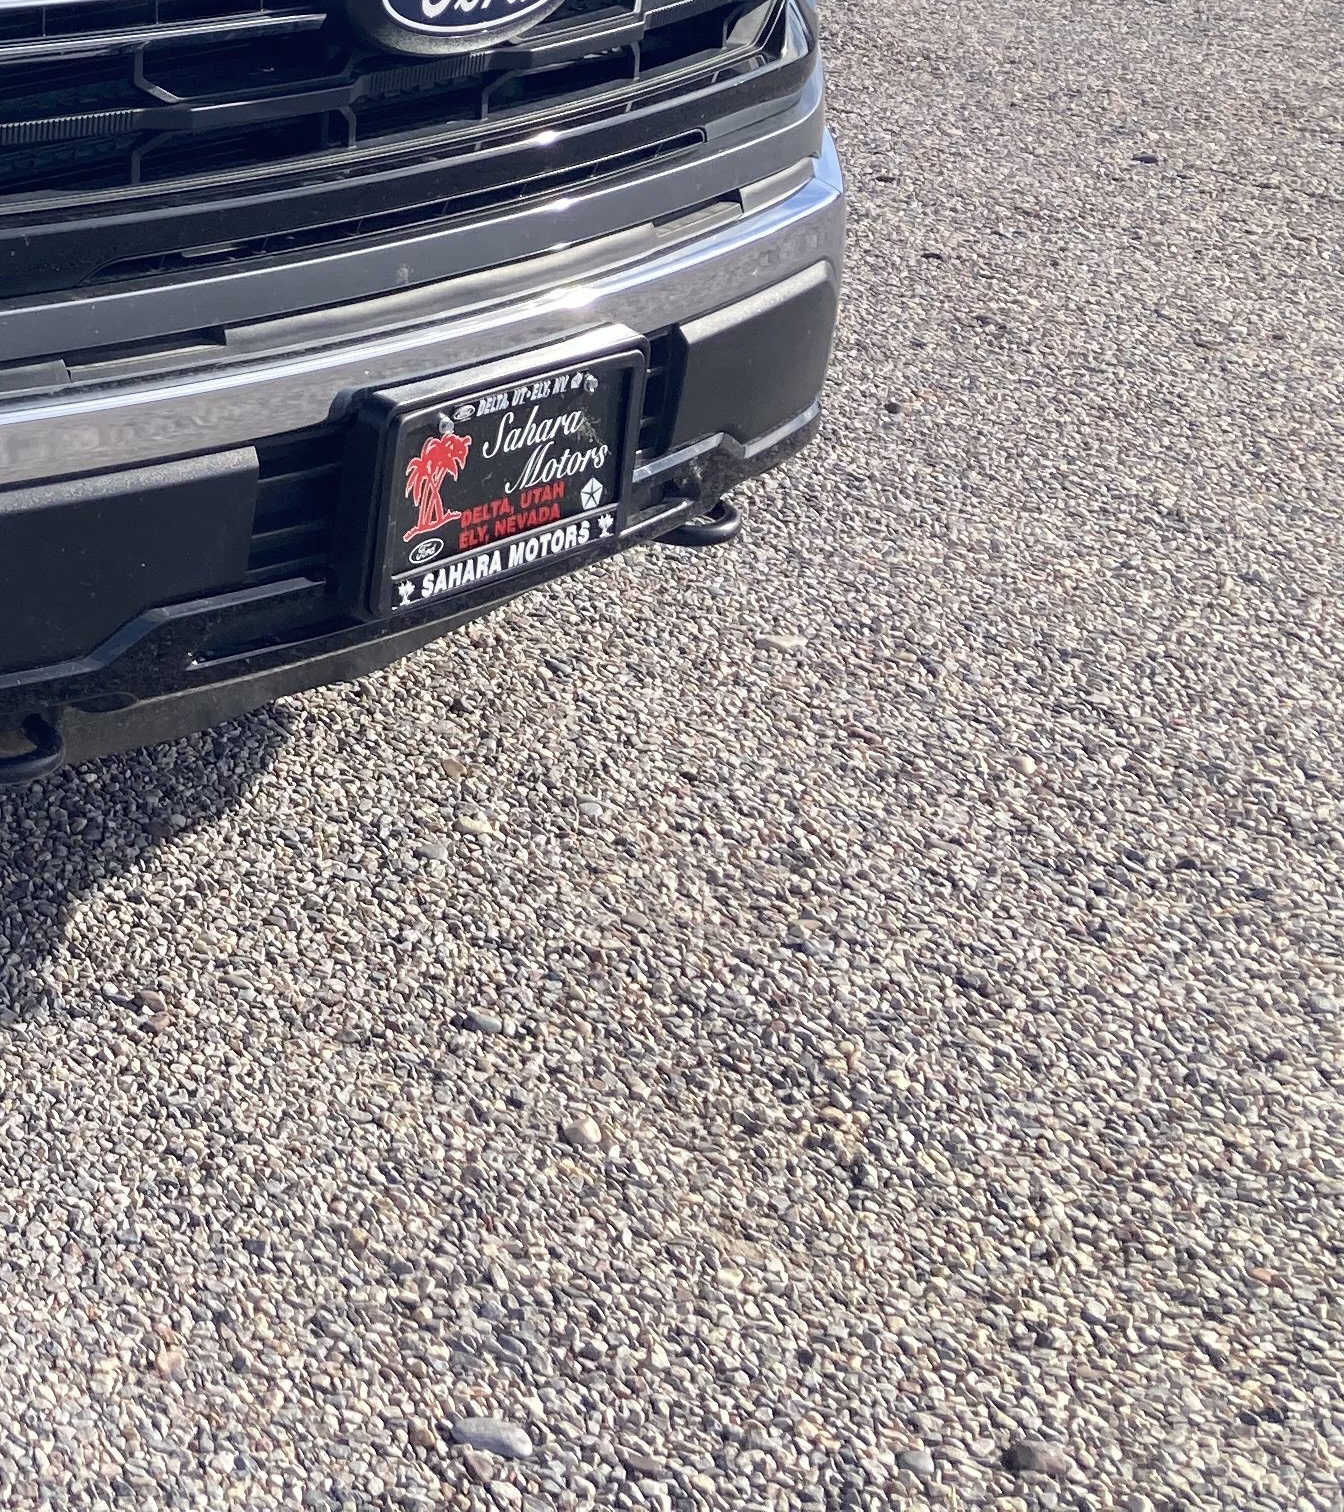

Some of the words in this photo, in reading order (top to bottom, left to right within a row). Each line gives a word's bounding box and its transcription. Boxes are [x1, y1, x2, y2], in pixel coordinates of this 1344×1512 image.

[482, 405, 584, 459] Sahara
[505, 441, 609, 494] Motors
[458, 524, 490, 551] ELY,
[494, 502, 561, 537] NEVADA
[459, 497, 515, 529] DELTA,
[520, 482, 565, 509] UTAH
[420, 550, 502, 598] SAHARA
[508, 520, 591, 569] MOTORS
